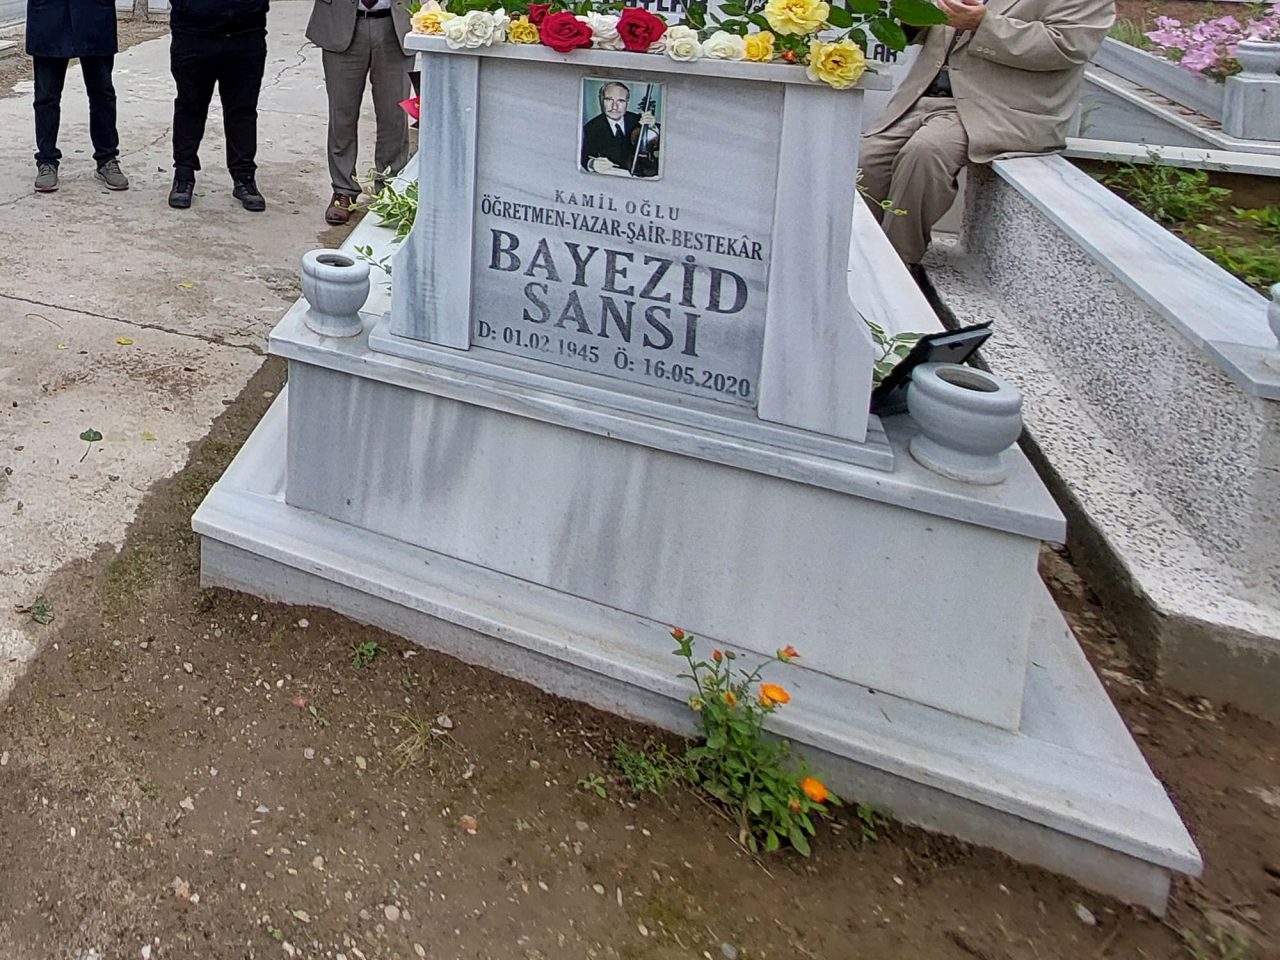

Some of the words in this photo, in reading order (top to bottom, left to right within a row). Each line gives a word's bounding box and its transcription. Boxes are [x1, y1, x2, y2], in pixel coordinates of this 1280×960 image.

[554, 189, 618, 212] KAMİL
[625, 199, 680, 221] OĞLU
[488, 227, 749, 315] BAYEZİD
[477, 319, 497, 340] D:
[613, 346, 635, 372] Ö:
[643, 358, 751, 398] 16.05.2020
[522, 281, 702, 358] SANSI
